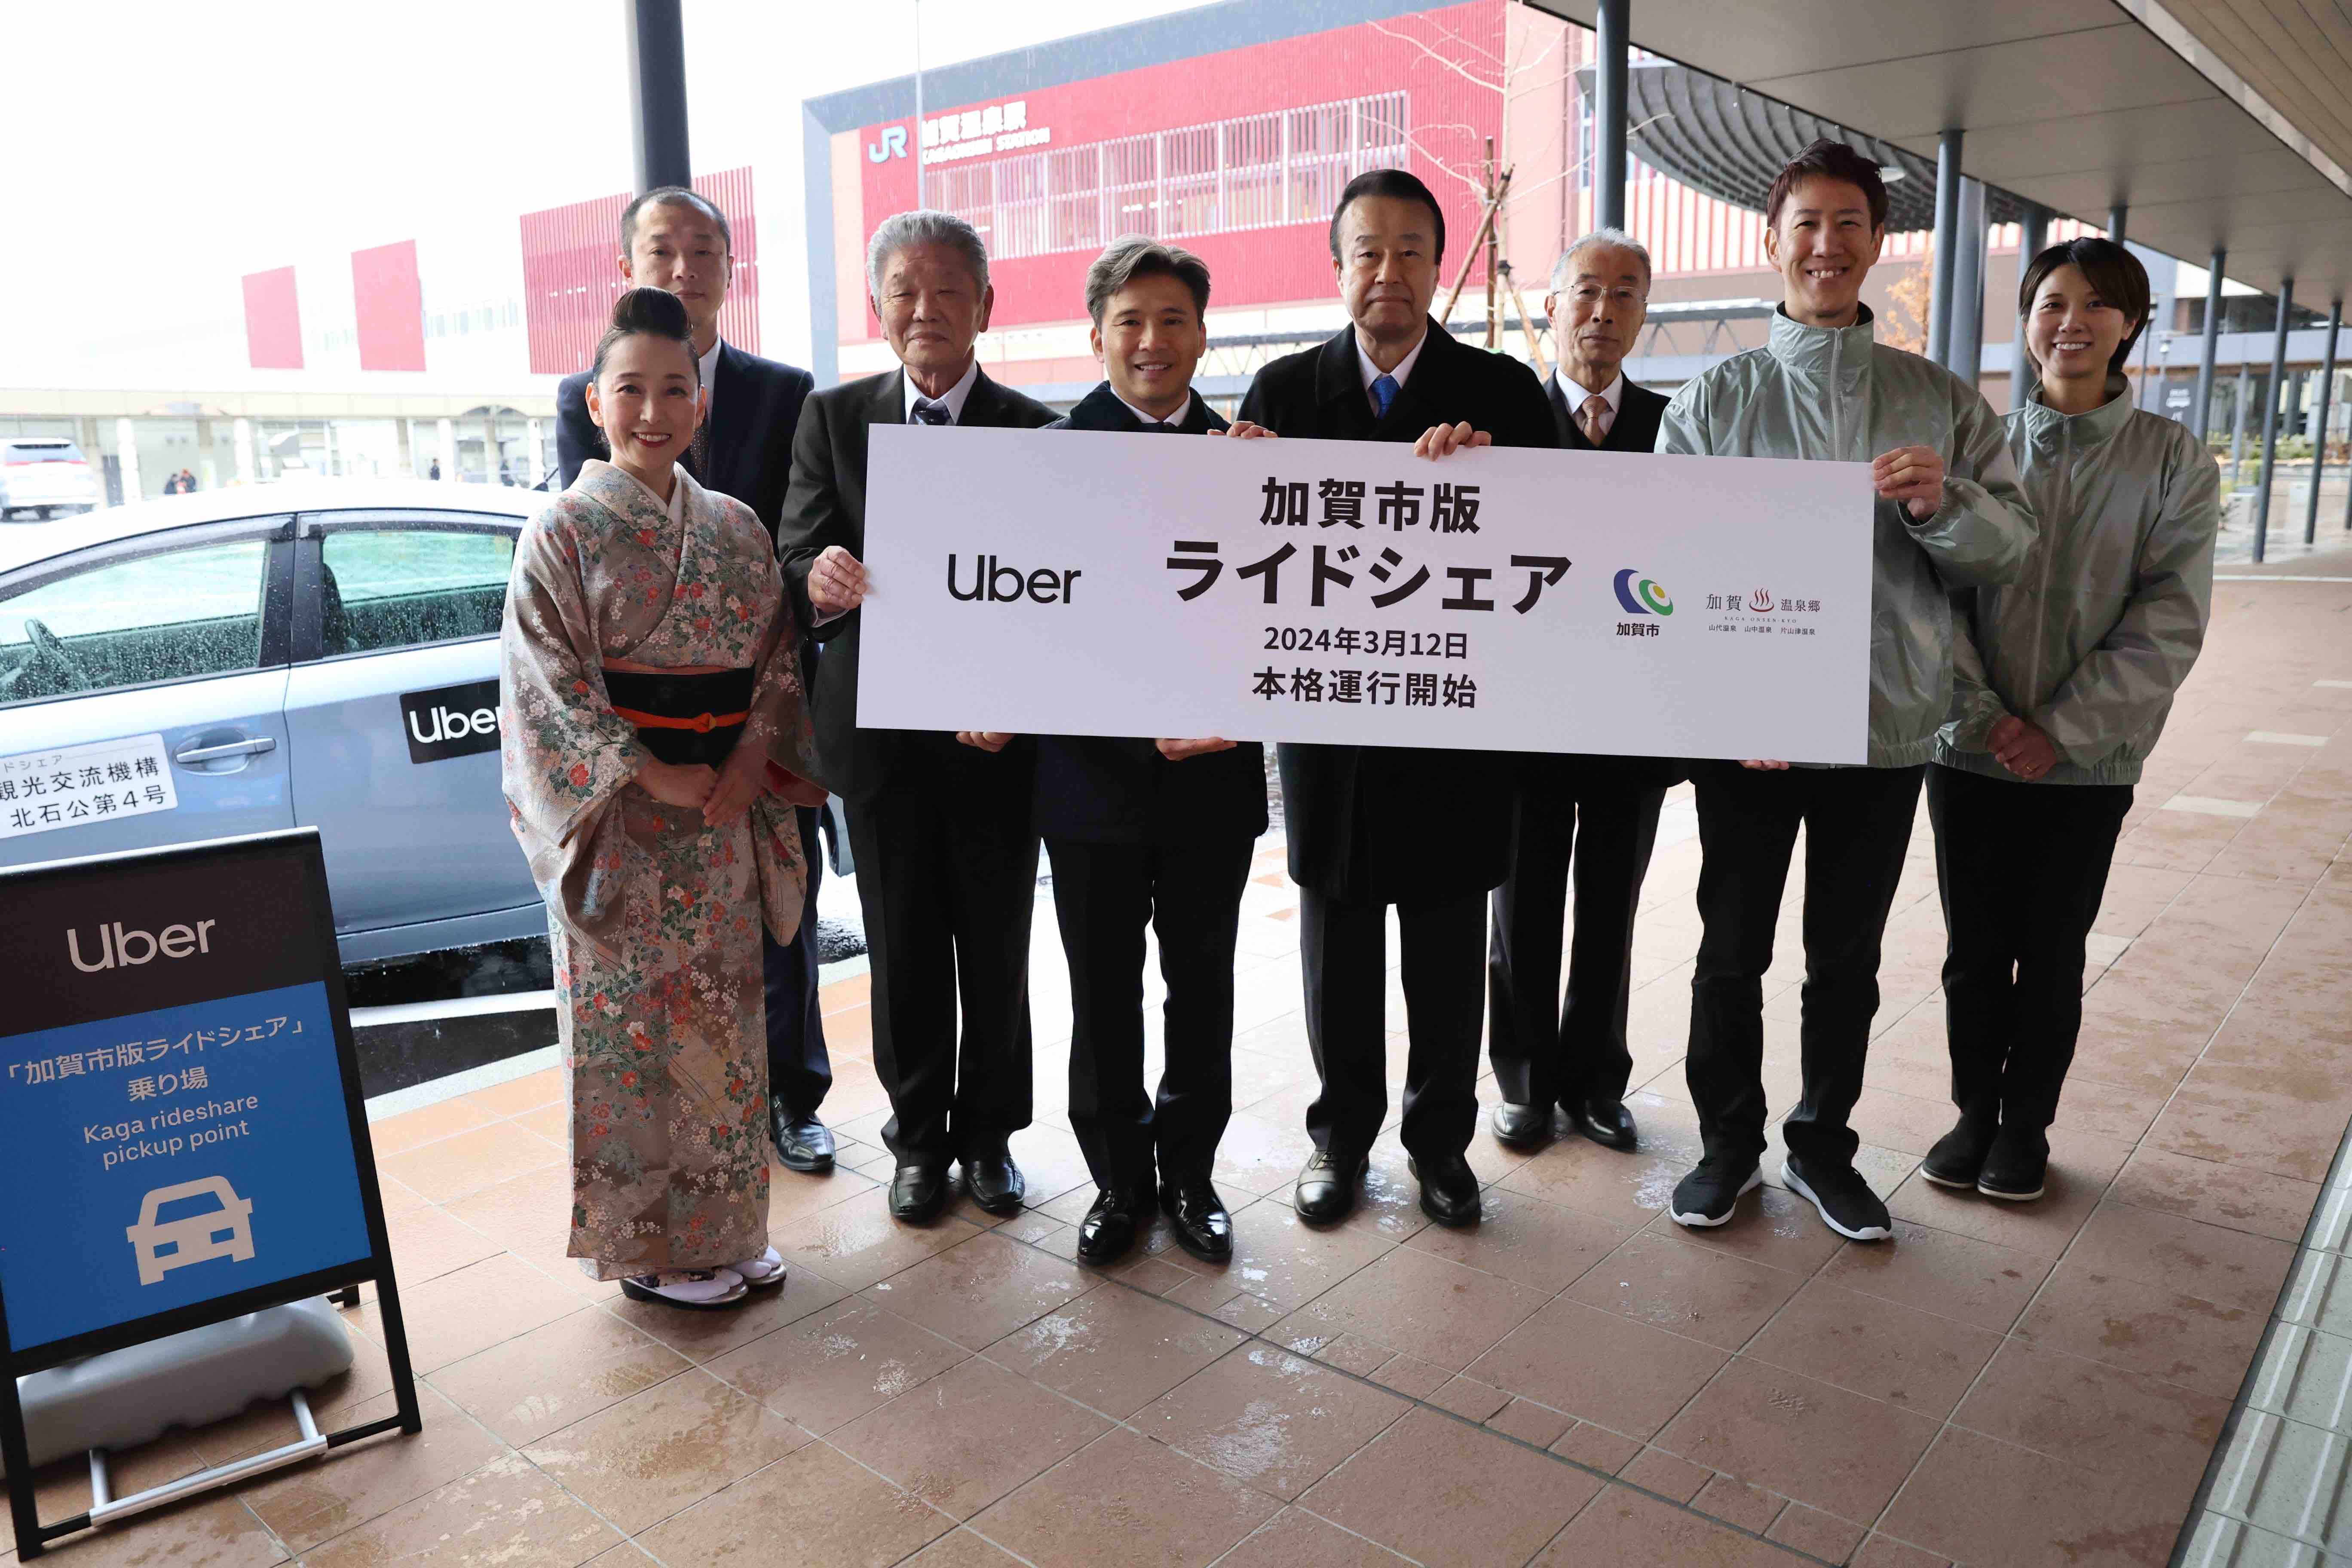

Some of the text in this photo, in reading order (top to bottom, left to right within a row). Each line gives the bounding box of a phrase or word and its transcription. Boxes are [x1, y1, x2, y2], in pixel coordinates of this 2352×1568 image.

[869, 125, 908, 164] JR
[996, 127, 1050, 151] STATION
[1260, 477, 1480, 534] 加賀市版
[948, 554, 1081, 603] Uber
[1167, 541, 1571, 614] ライドシェア
[1706, 594, 1820, 612] 加賀 温泉郷
[1264, 627, 1467, 659] 2024年3月12日
[1616, 622, 1660, 637] 加賀市
[1709, 624, 1736, 632] 山代温泉
[1781, 627, 1816, 635] 片山津温泉
[1253, 666, 1477, 708] 本格運行開始
[10, 784, 166, 829] 北石公第4号
[67, 919, 216, 972] Uber
[9, 1016, 302, 1085] 「加賀市版ライドシェア」
[128, 1066, 208, 1102] 乗り場
[83, 1094, 259, 1144] Kaga rideshare
[103, 1119, 249, 1170] pickup point
